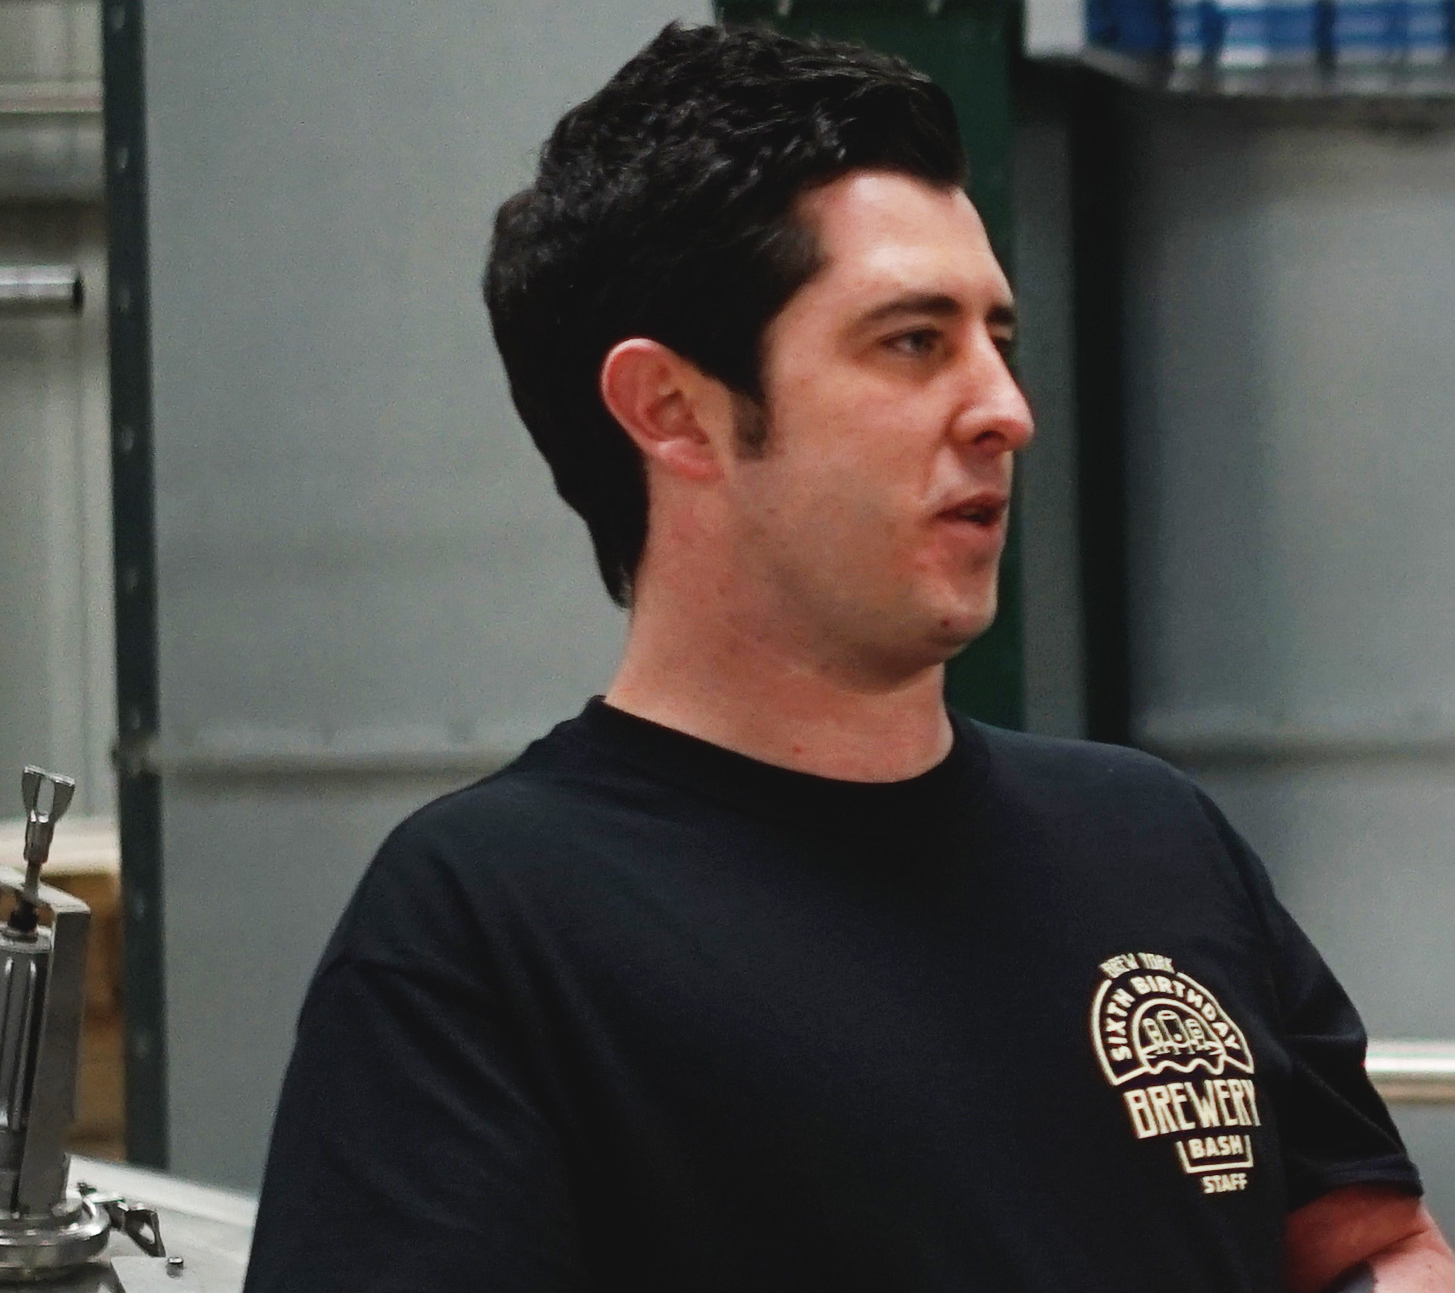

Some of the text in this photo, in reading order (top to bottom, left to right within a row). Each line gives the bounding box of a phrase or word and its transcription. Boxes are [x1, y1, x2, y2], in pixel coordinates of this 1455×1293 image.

[1106, 975, 1241, 1062] SIXTH BIRTHDAY
[1123, 1079, 1262, 1140] BREWERY
[1188, 1134, 1244, 1159] BASH
[1202, 1172, 1248, 1194] STAFF
